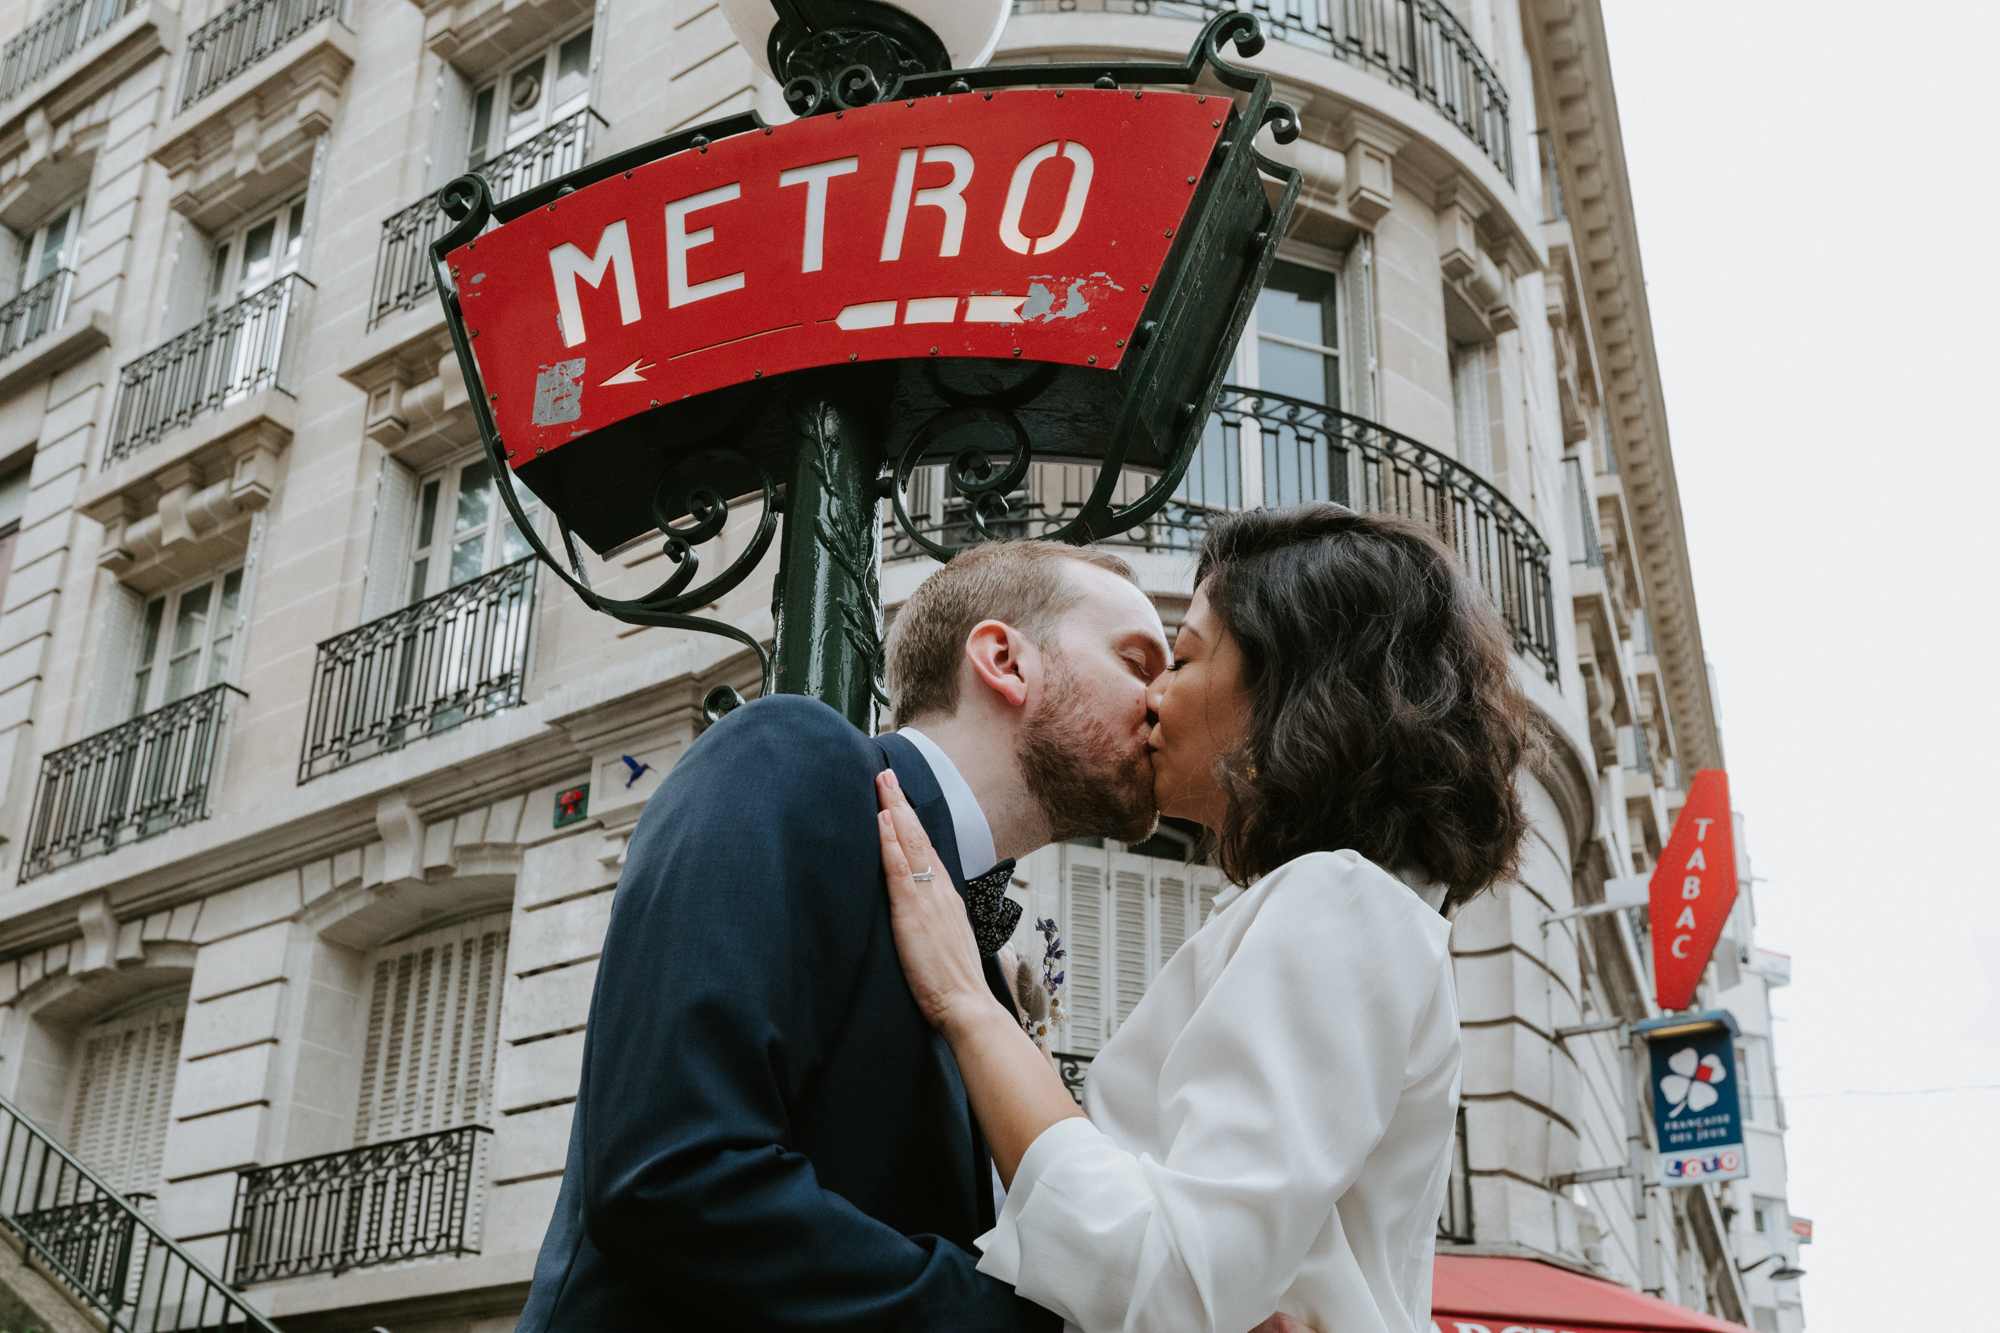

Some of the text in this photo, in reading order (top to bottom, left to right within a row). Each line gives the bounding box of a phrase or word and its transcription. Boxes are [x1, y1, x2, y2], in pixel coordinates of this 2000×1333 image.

[549, 139, 1095, 348] METRO
[1671, 817, 1715, 959] TABAC
[1664, 1151, 1741, 1179] LOTO
[1669, 1126, 1728, 1144] DES JEUX
